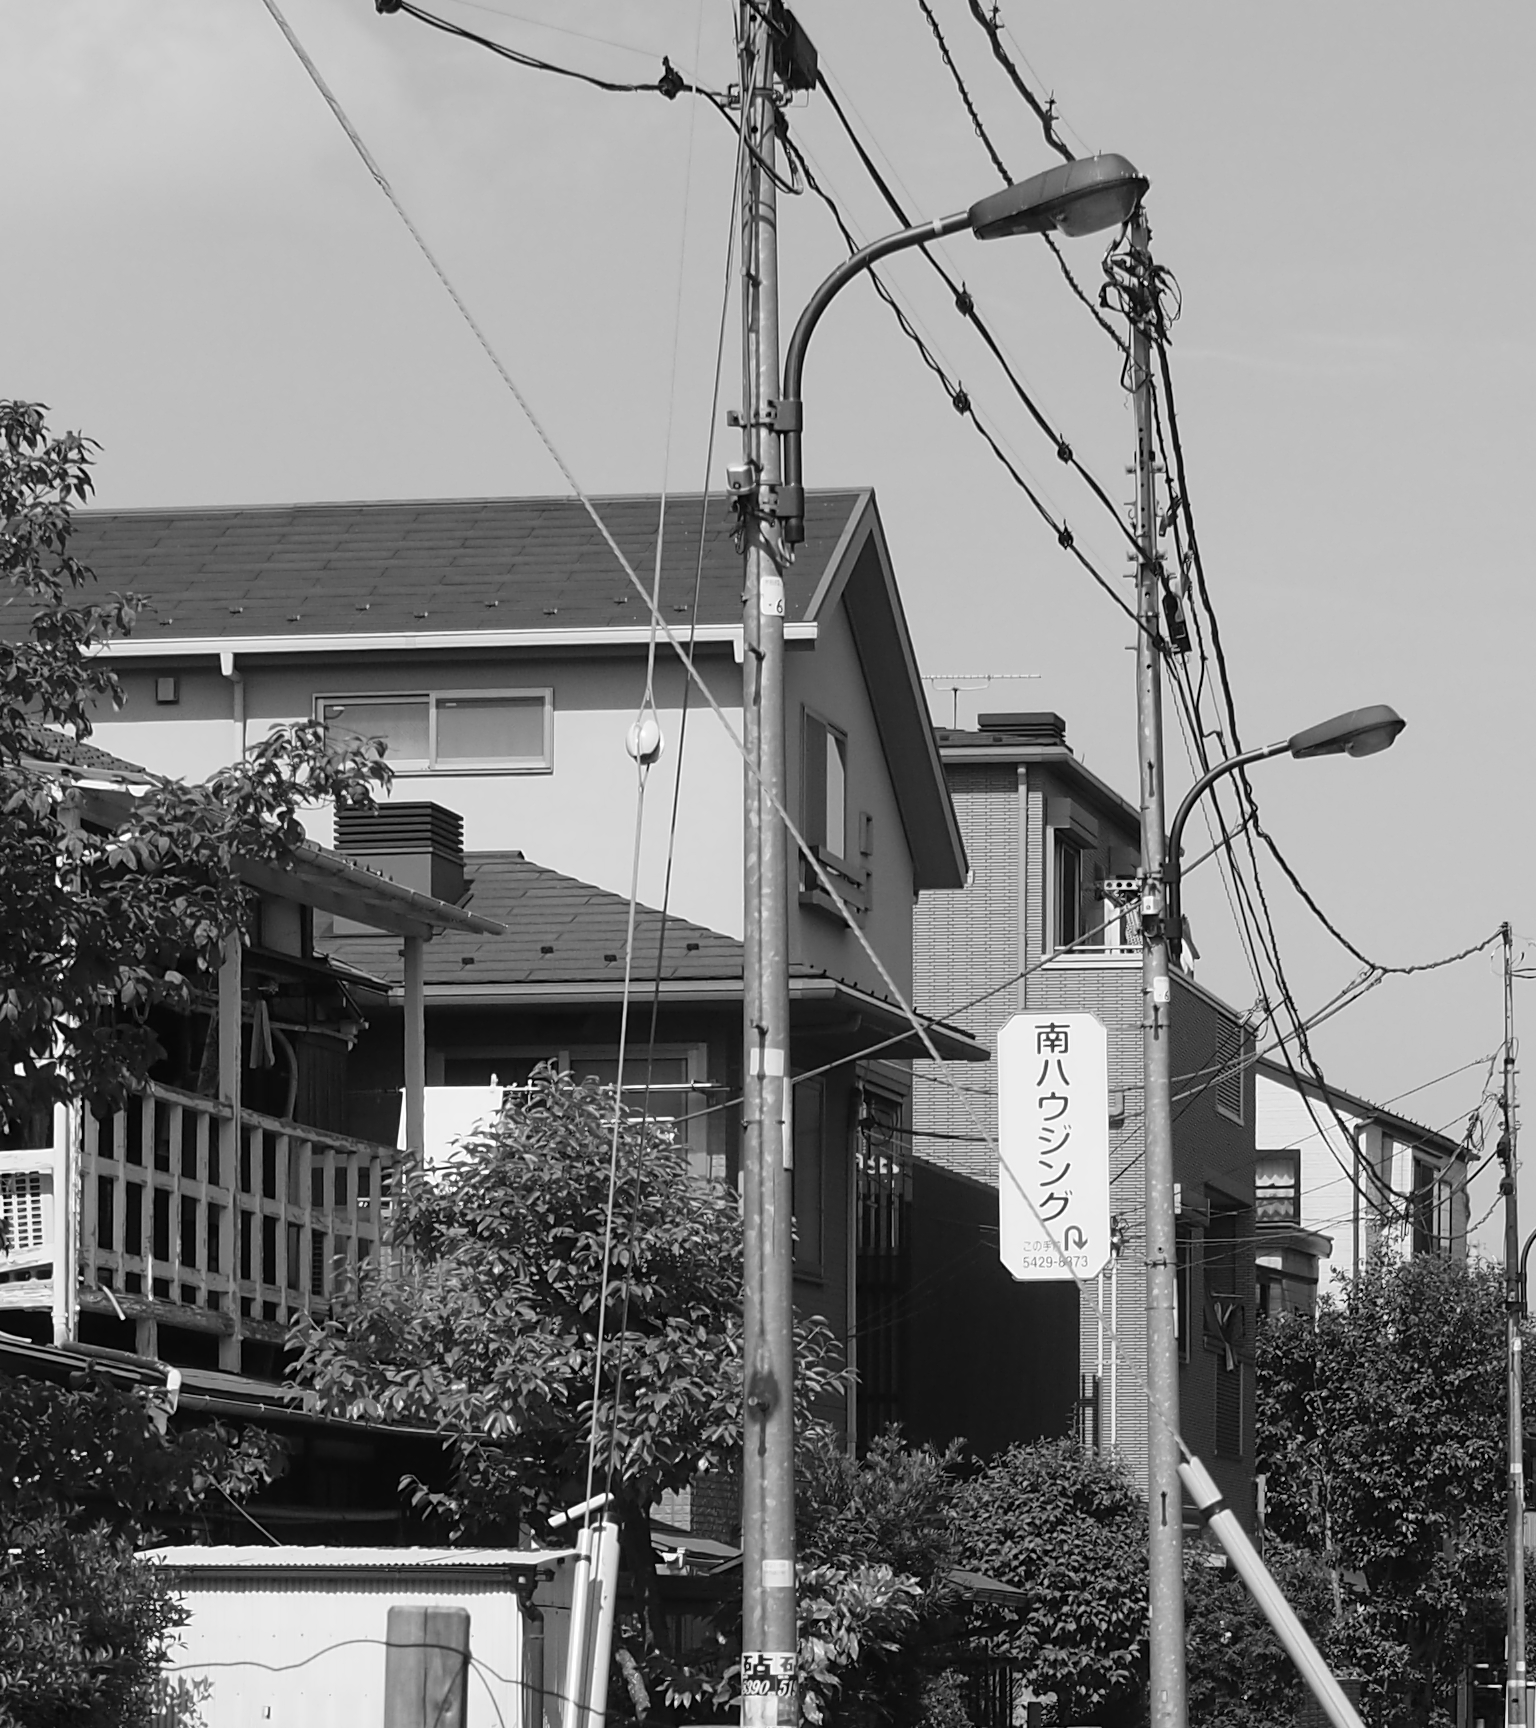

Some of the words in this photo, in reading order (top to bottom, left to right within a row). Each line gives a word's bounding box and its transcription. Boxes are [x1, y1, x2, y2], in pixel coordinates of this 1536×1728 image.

[1035, 1022, 1073, 1223] 南ハウジング
